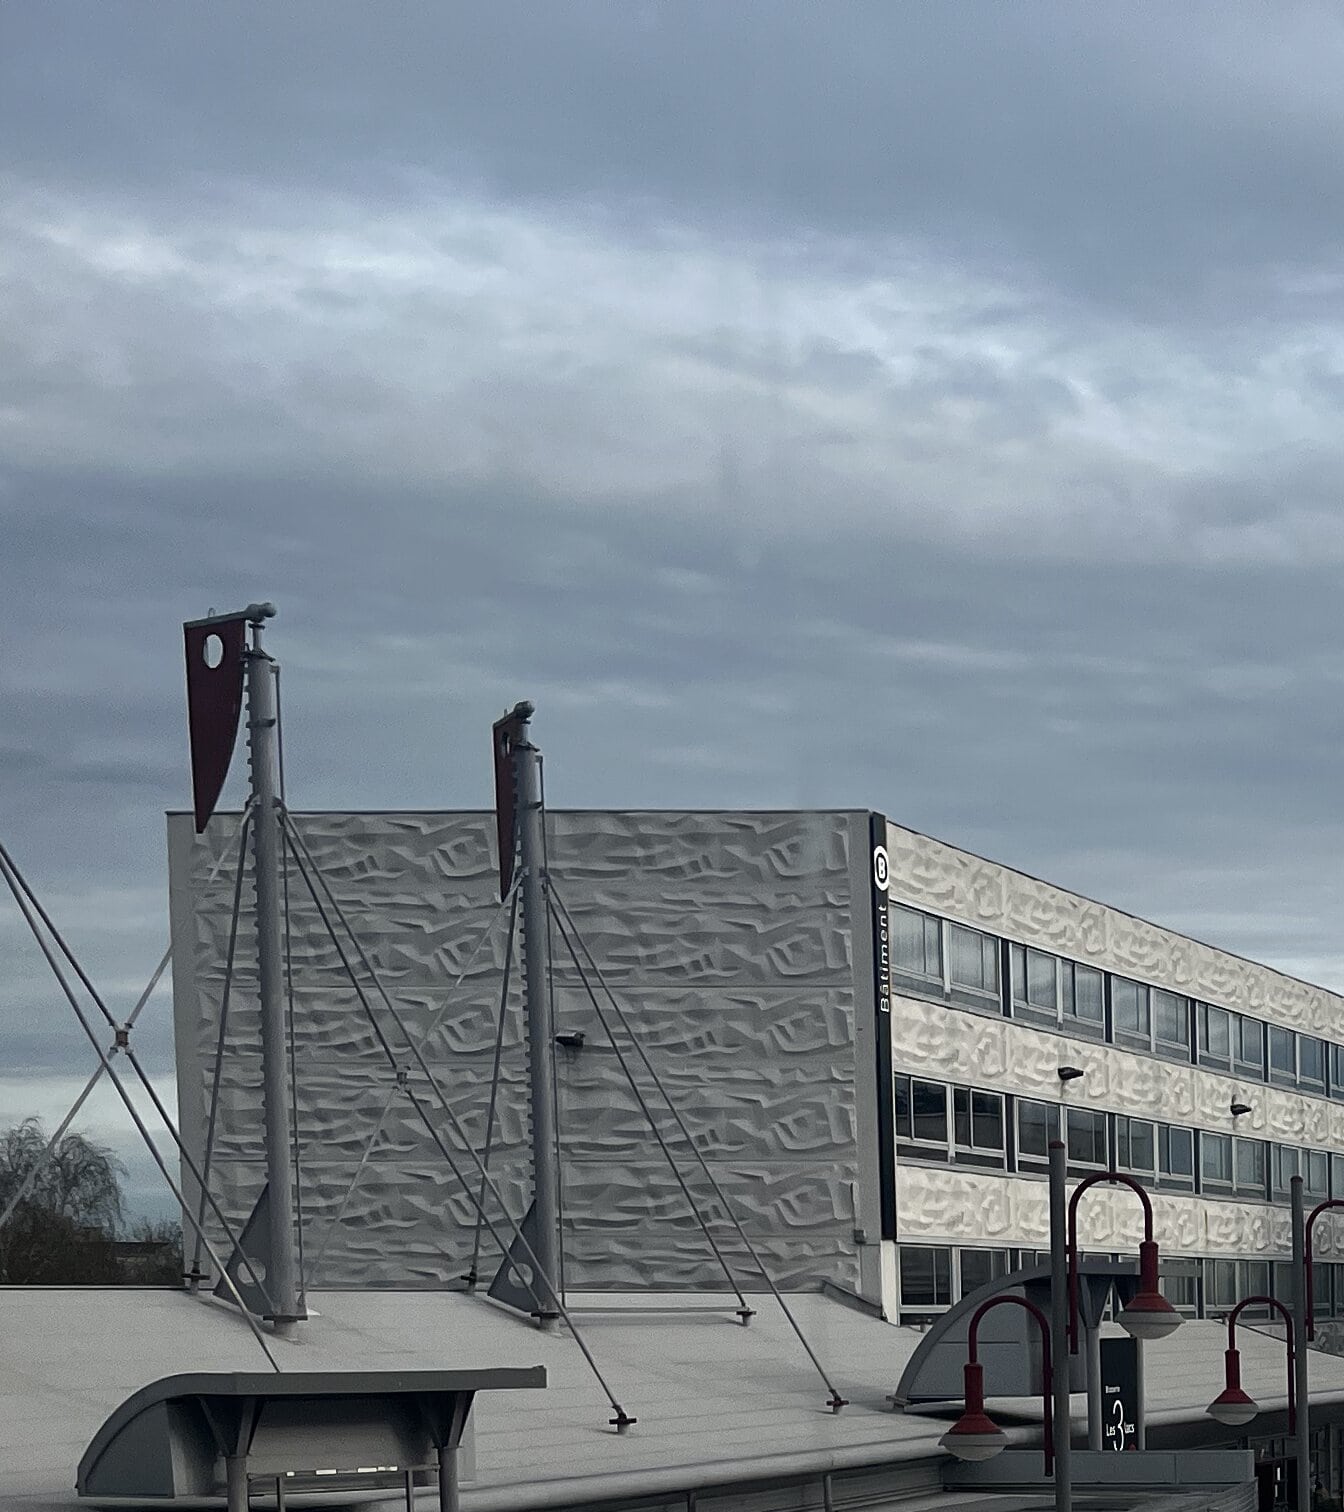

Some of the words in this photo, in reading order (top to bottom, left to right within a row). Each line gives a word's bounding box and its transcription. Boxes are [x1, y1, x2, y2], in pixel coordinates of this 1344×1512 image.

[879, 905, 890, 1012] Bâtiment
[1106, 1423, 1116, 1436] Les
[1112, 1400, 1124, 1451] 3
